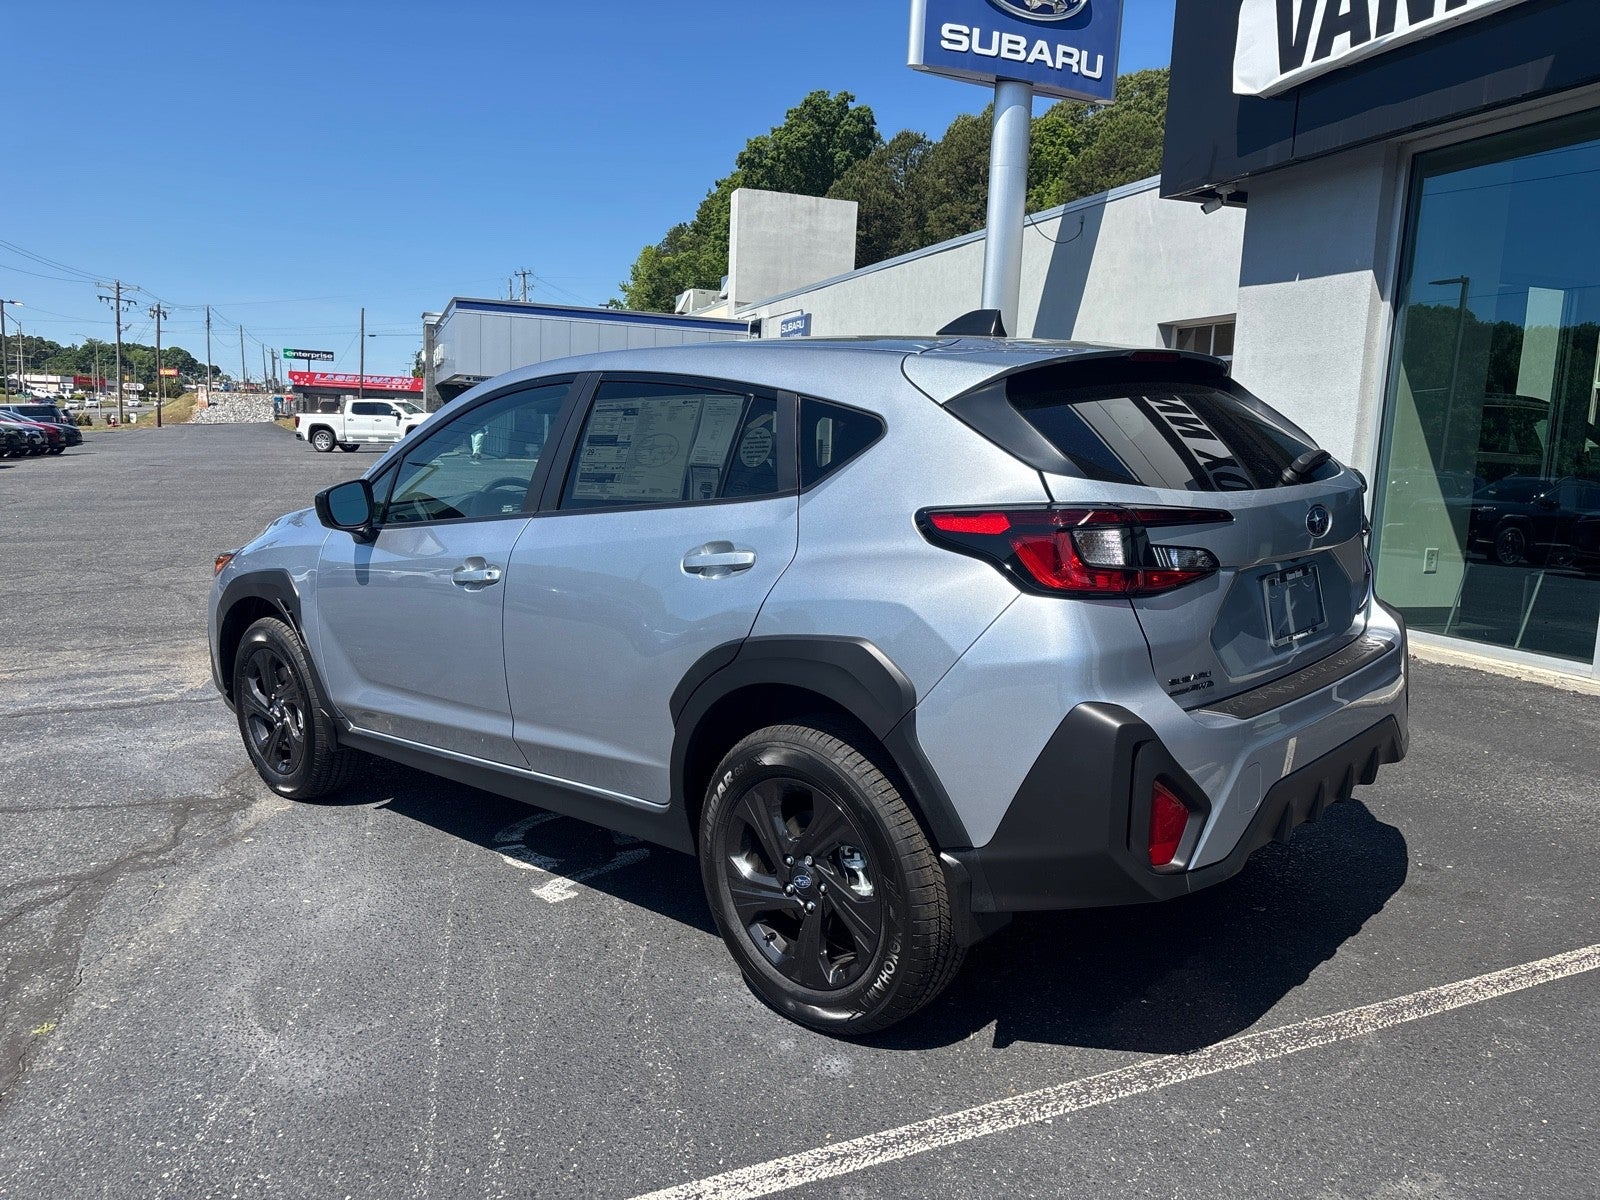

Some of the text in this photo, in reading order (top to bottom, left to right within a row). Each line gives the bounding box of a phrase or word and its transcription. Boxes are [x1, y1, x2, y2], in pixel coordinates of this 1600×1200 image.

[940, 22, 1104, 80] SUBARU
[781, 319, 805, 334] SUBARU
[285, 350, 333, 360] enterprise
